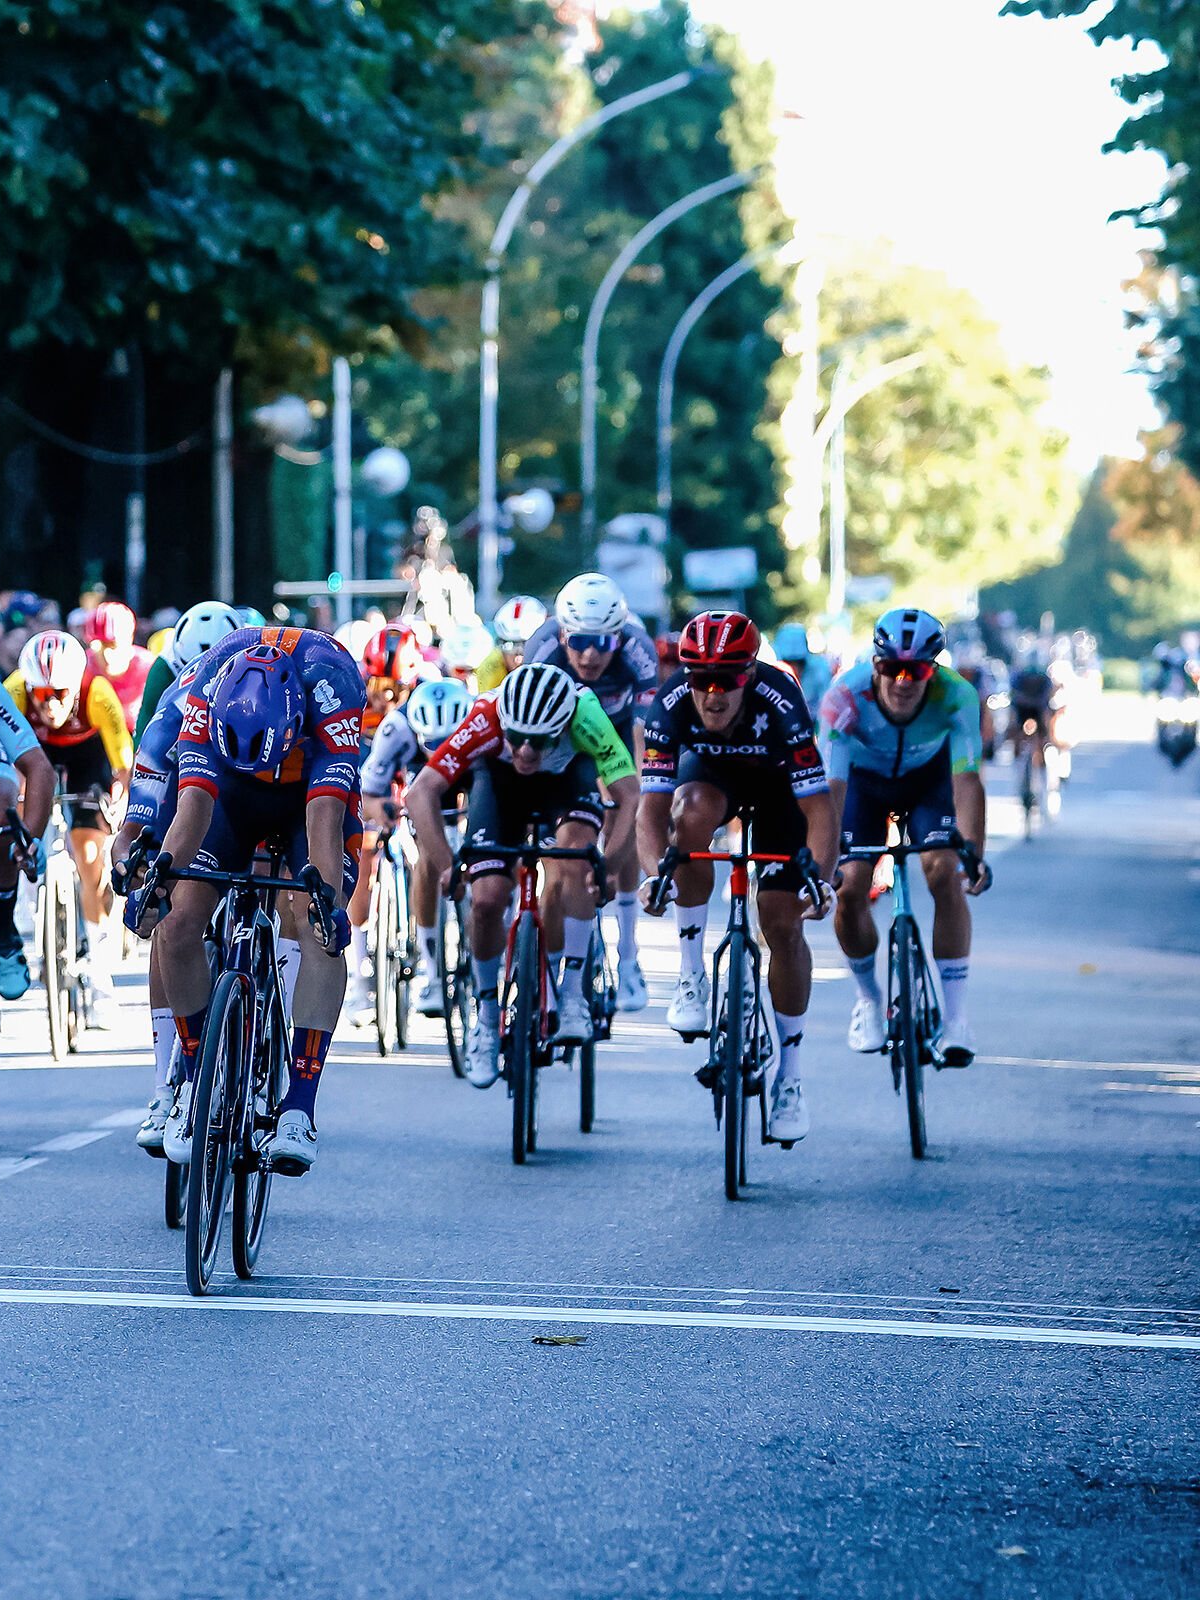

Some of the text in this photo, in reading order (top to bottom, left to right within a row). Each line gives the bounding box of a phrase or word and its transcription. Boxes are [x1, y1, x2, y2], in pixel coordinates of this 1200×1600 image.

[755, 681, 794, 714] BMC
[261, 727, 276, 763] LAZER
[644, 728, 669, 745] MSC
[693, 743, 768, 755] TUDOR
